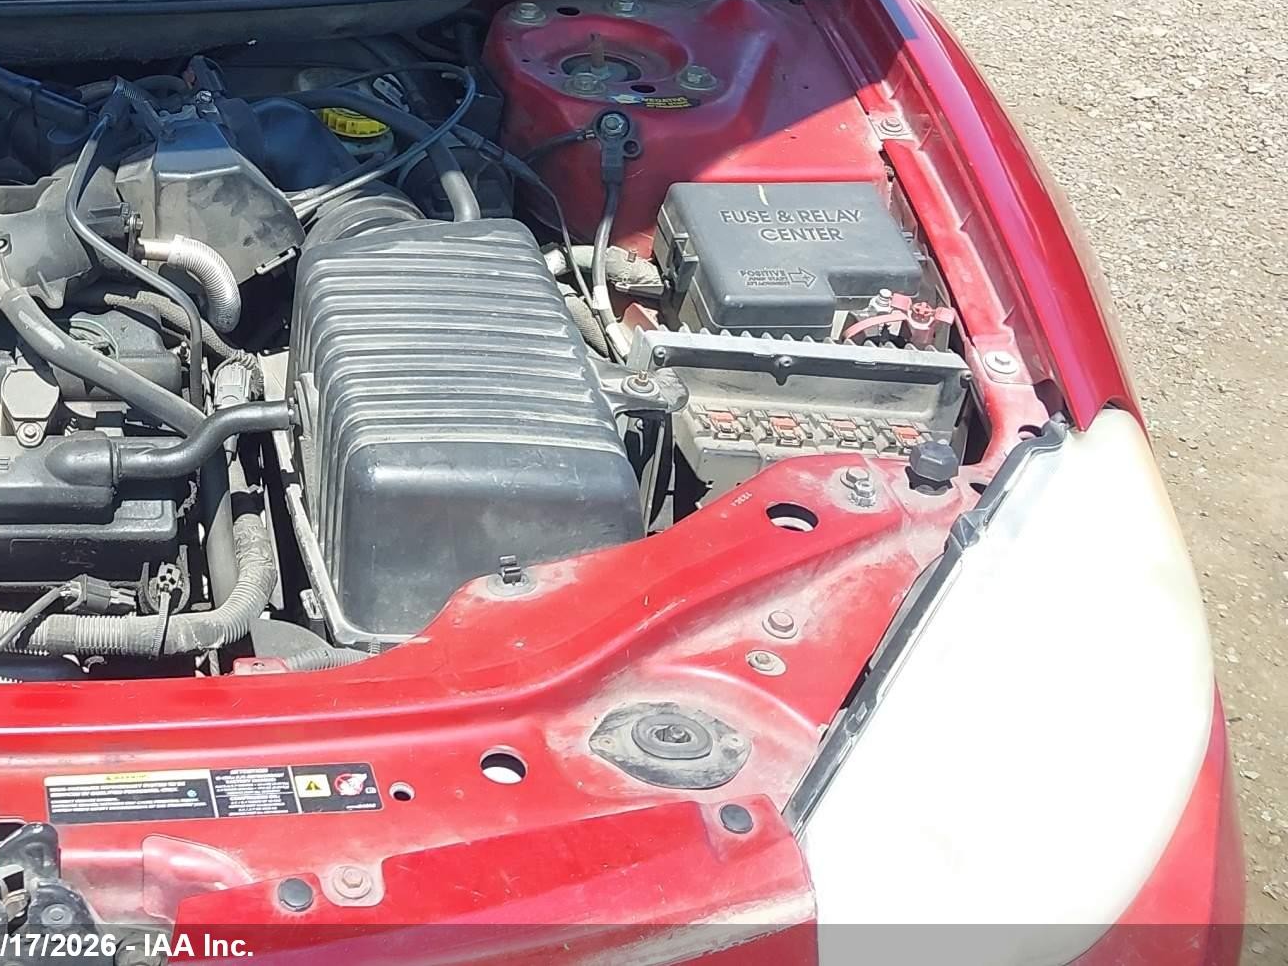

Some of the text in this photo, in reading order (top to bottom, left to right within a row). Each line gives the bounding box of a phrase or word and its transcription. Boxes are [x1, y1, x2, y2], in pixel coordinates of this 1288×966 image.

[719, 209, 863, 224] FUSE & RELAY
[760, 227, 846, 242] CENTER
